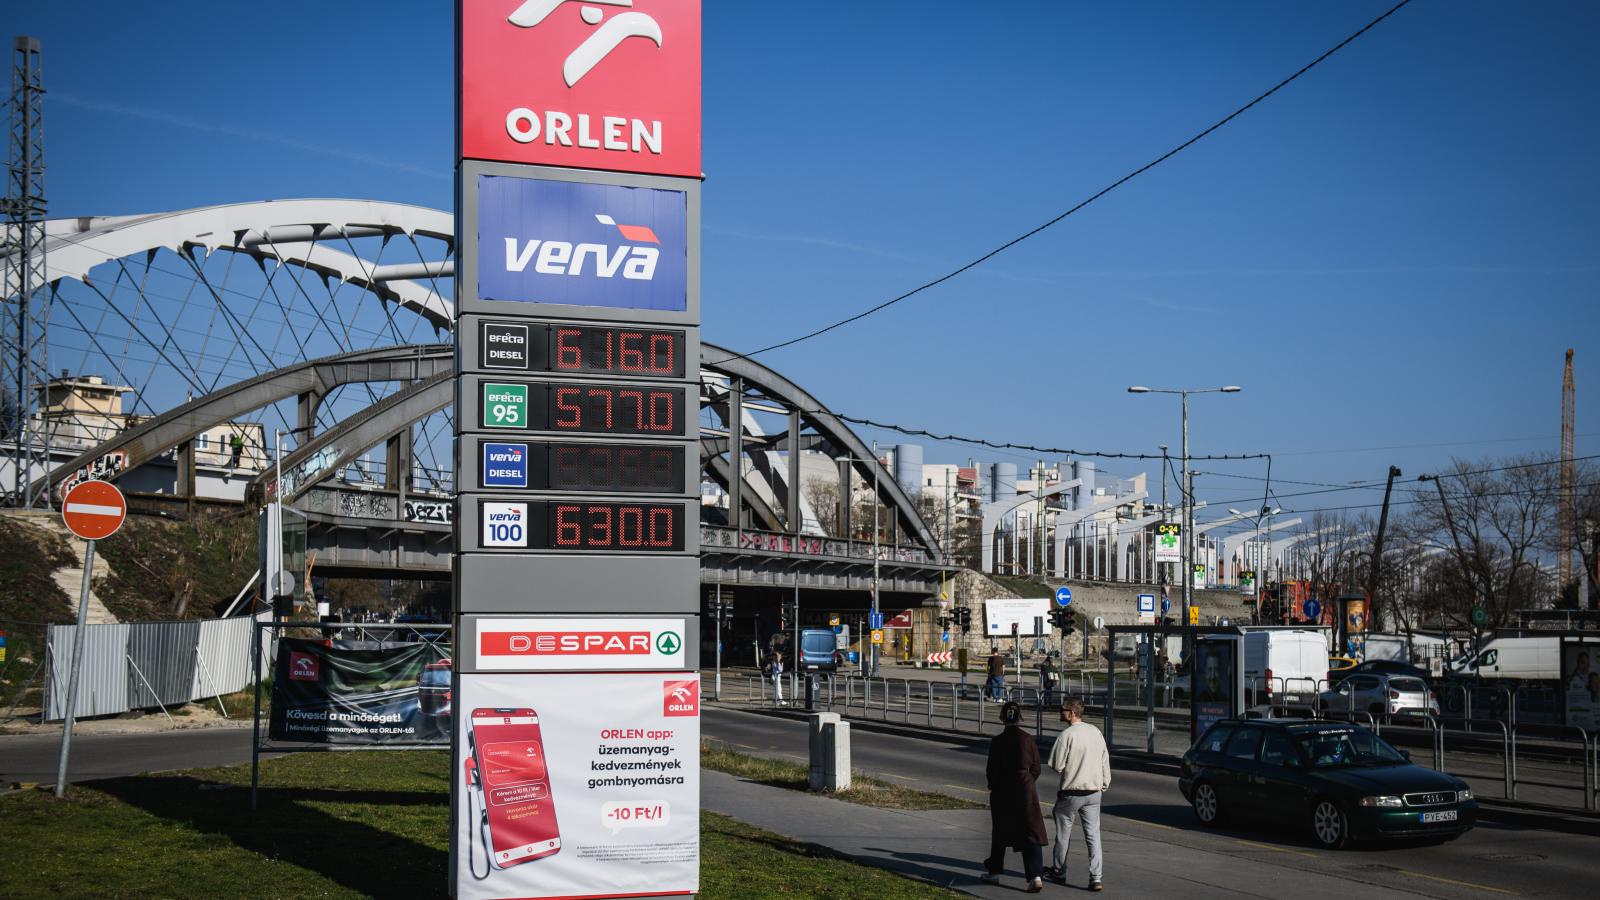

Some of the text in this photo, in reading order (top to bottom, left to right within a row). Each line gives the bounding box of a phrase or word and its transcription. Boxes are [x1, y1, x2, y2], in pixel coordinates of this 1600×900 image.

[506, 108, 662, 154] ORLEN
[505, 237, 660, 280] verva
[490, 350, 523, 360] DIESEL
[557, 329, 673, 373] 616.0
[493, 404, 519, 423] 95
[557, 388, 673, 431] 577.0
[489, 453, 522, 462] verva
[489, 469, 523, 478] DIESEL
[489, 512, 521, 521] verva
[489, 523, 522, 541] 100
[557, 506, 673, 547] 630.0
[1159, 525, 1178, 533] 0-24
[509, 635, 649, 651] DESPAR
[287, 709, 401, 724] Kövesd a minőséget!
[322, 725, 368, 734] üzemanyagok
[600, 729, 674, 740] ORLEN app:
[598, 744, 675, 756] üzemanyag-
[591, 759, 681, 772] kedvezmények
[587, 775, 684, 789] gombnyomásra
[607, 806, 662, 820] -10 Ft/l
